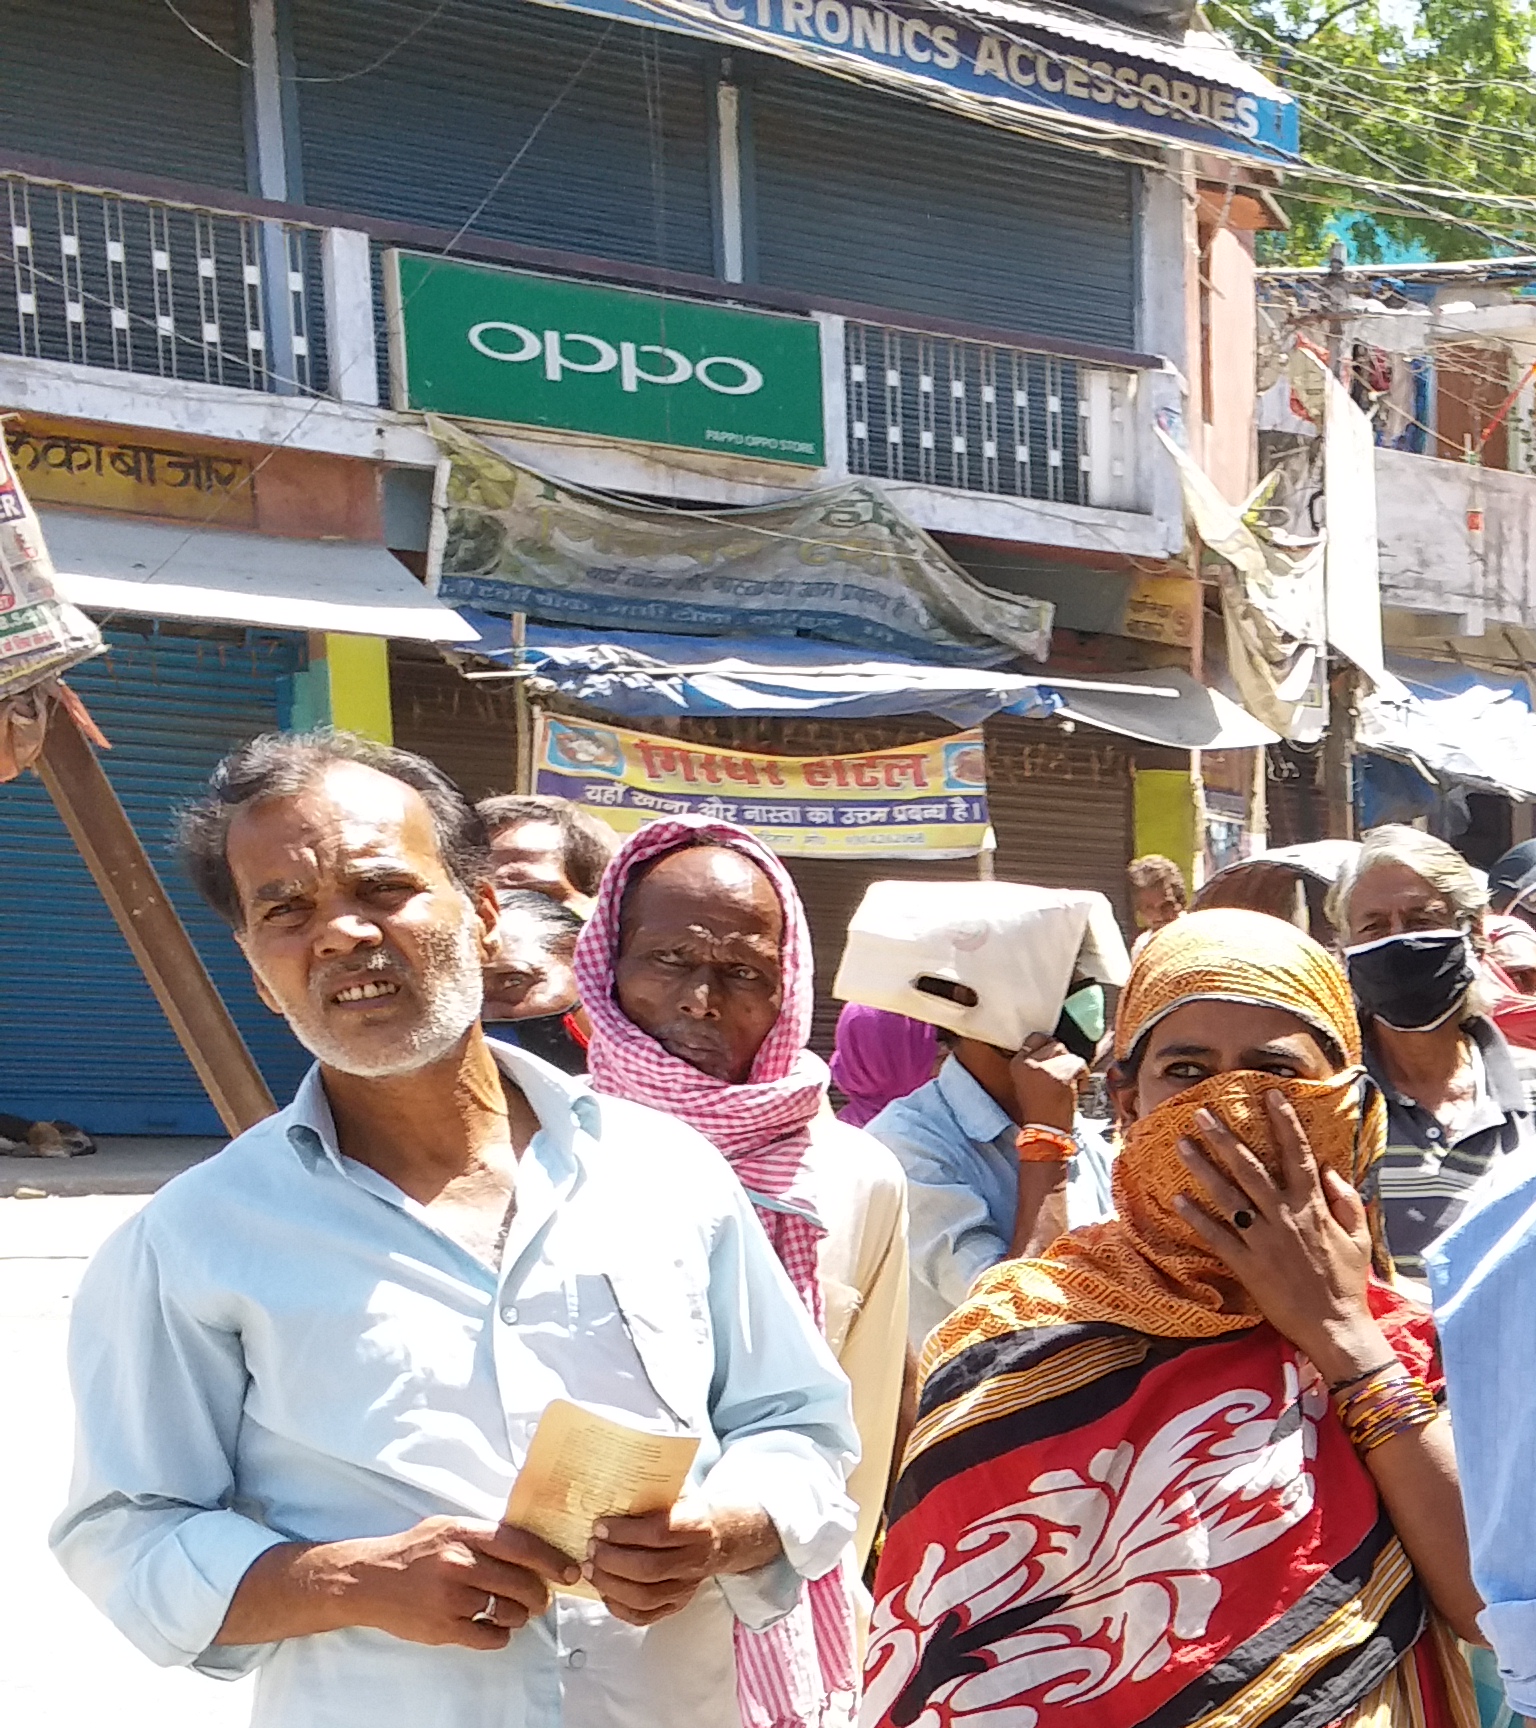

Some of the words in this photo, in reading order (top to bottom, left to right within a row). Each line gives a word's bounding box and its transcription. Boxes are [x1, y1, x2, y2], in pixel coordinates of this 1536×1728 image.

[688, 0, 960, 69] CTRONICS
[974, 36, 1260, 138] ACCESSORIES
[744, 434, 779, 450] OPPO
[630, 790, 691, 814] खाना
[698, 796, 738, 822] और
[803, 806, 835, 825] का
[838, 806, 891, 825] उत्तम
